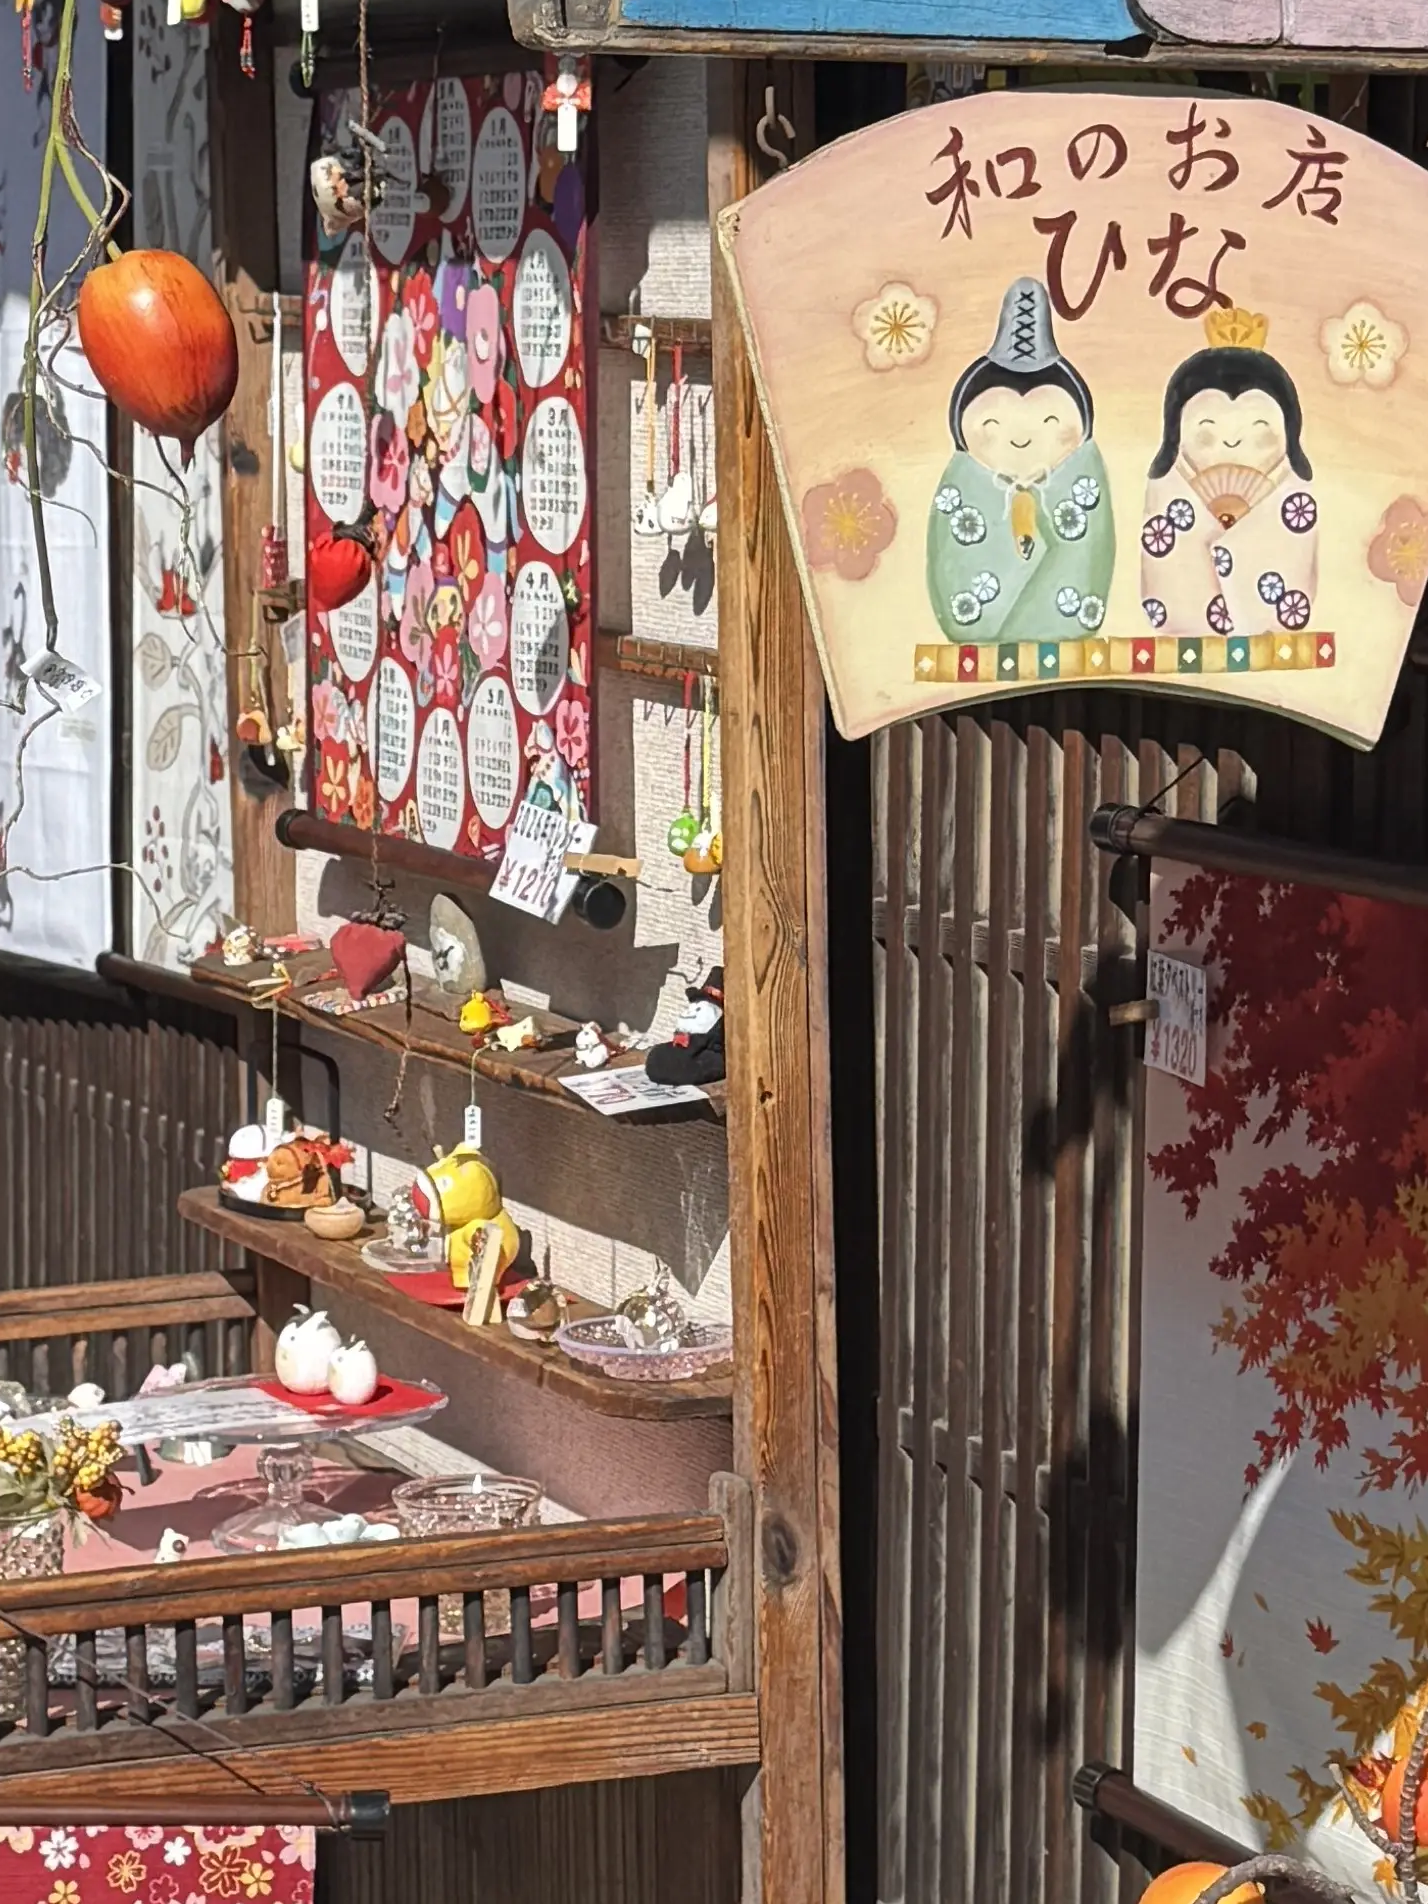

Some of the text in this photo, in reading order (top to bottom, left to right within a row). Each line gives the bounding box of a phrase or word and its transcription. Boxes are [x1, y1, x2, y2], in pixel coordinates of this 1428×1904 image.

[924, 101, 1351, 241] 和のお店
[1032, 208, 1249, 322] ひな
[1150, 1018, 1197, 1078] ¥1320
